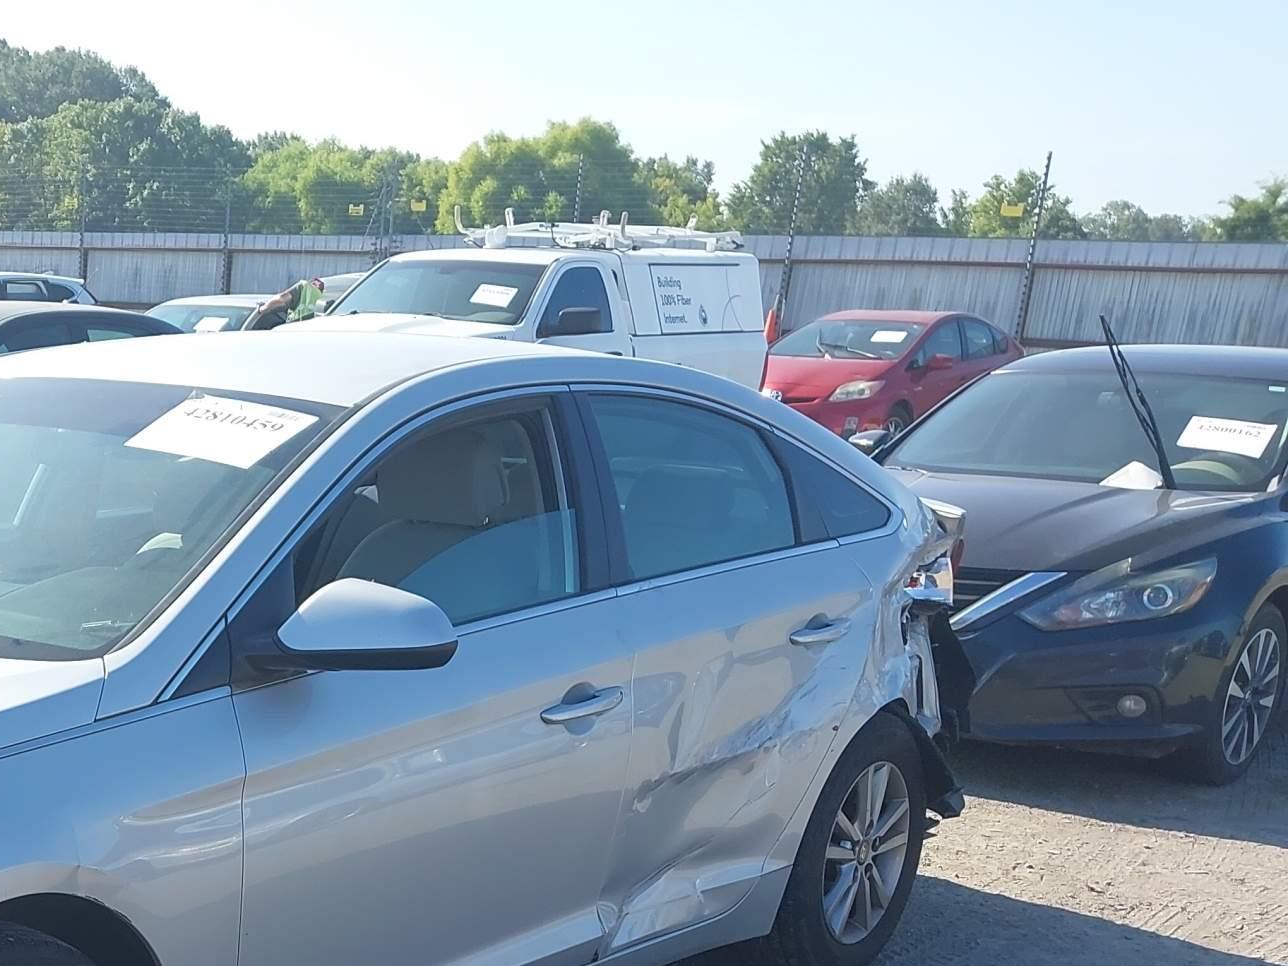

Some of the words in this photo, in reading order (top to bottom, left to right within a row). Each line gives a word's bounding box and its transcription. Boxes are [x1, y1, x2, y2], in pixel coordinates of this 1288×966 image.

[657, 276, 681, 290] Building
[661, 294, 677, 306] 100%
[184, 407, 285, 432] 42810459
